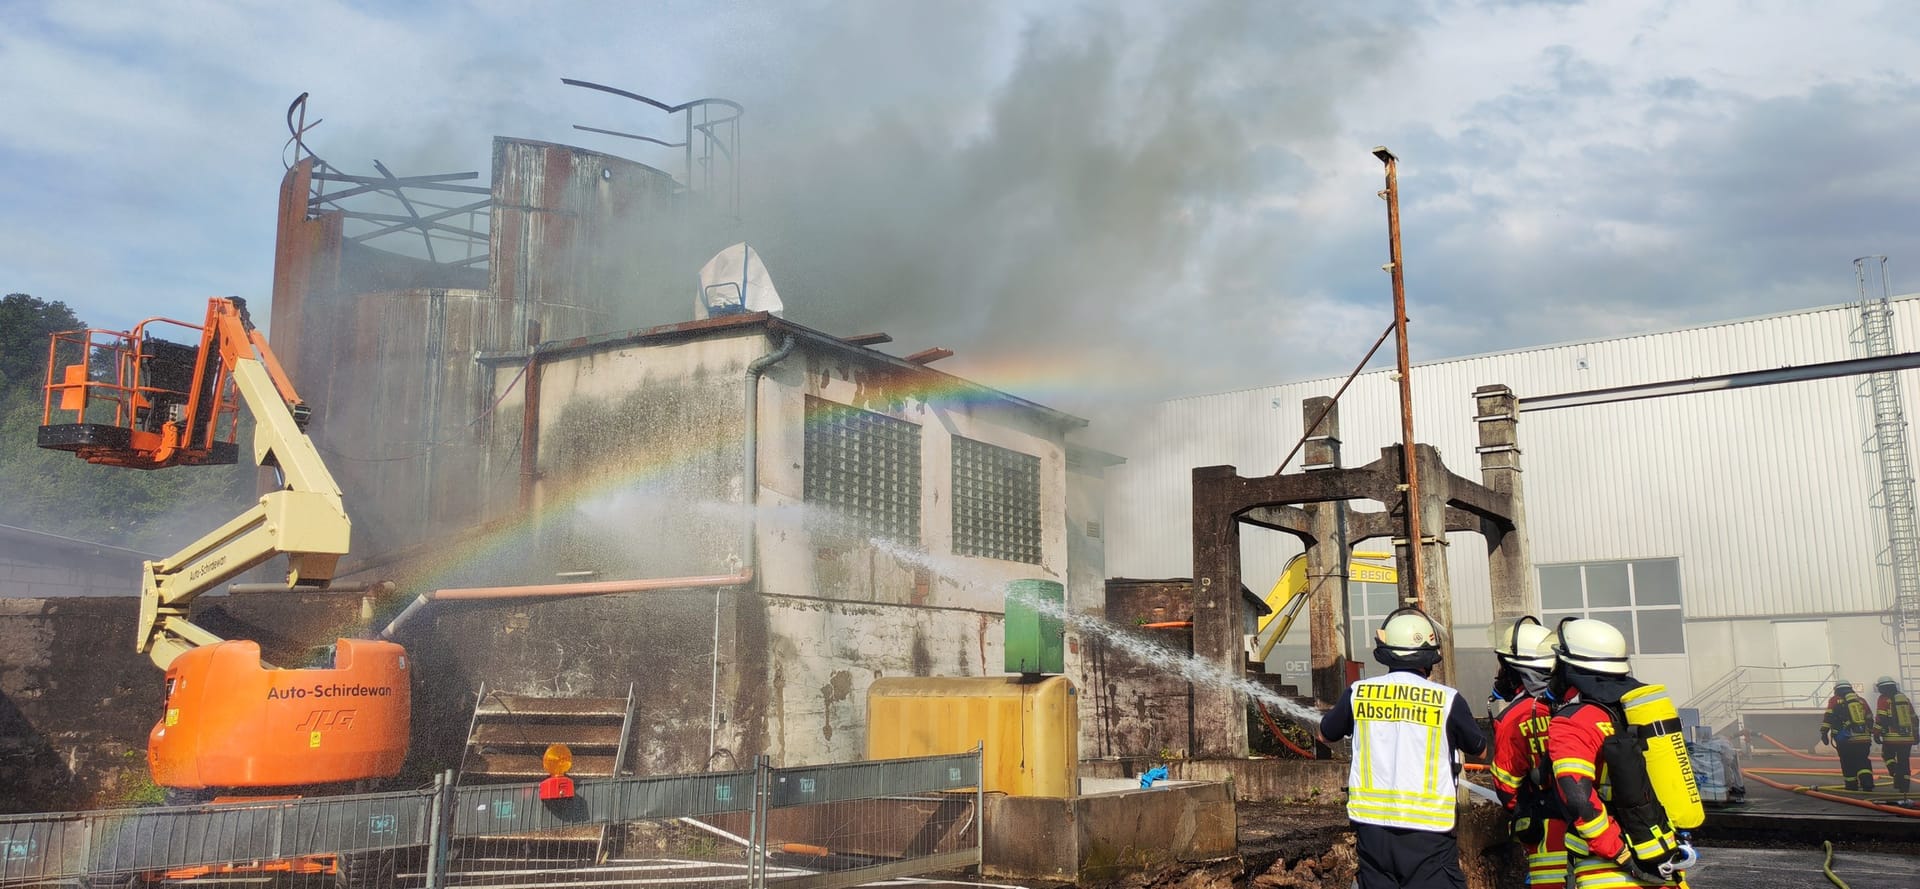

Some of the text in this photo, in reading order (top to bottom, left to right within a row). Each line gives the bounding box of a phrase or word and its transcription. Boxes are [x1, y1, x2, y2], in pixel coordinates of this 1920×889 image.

[1360, 570, 1392, 581] BESIC
[267, 684, 392, 700] Auto-Schirdewan
[1356, 684, 1443, 705] ETTLINGEN
[295, 709, 357, 732] JLG
[1356, 702, 1441, 725] Abschnitt 1
[1671, 733, 1700, 804] FEUERWEHR
